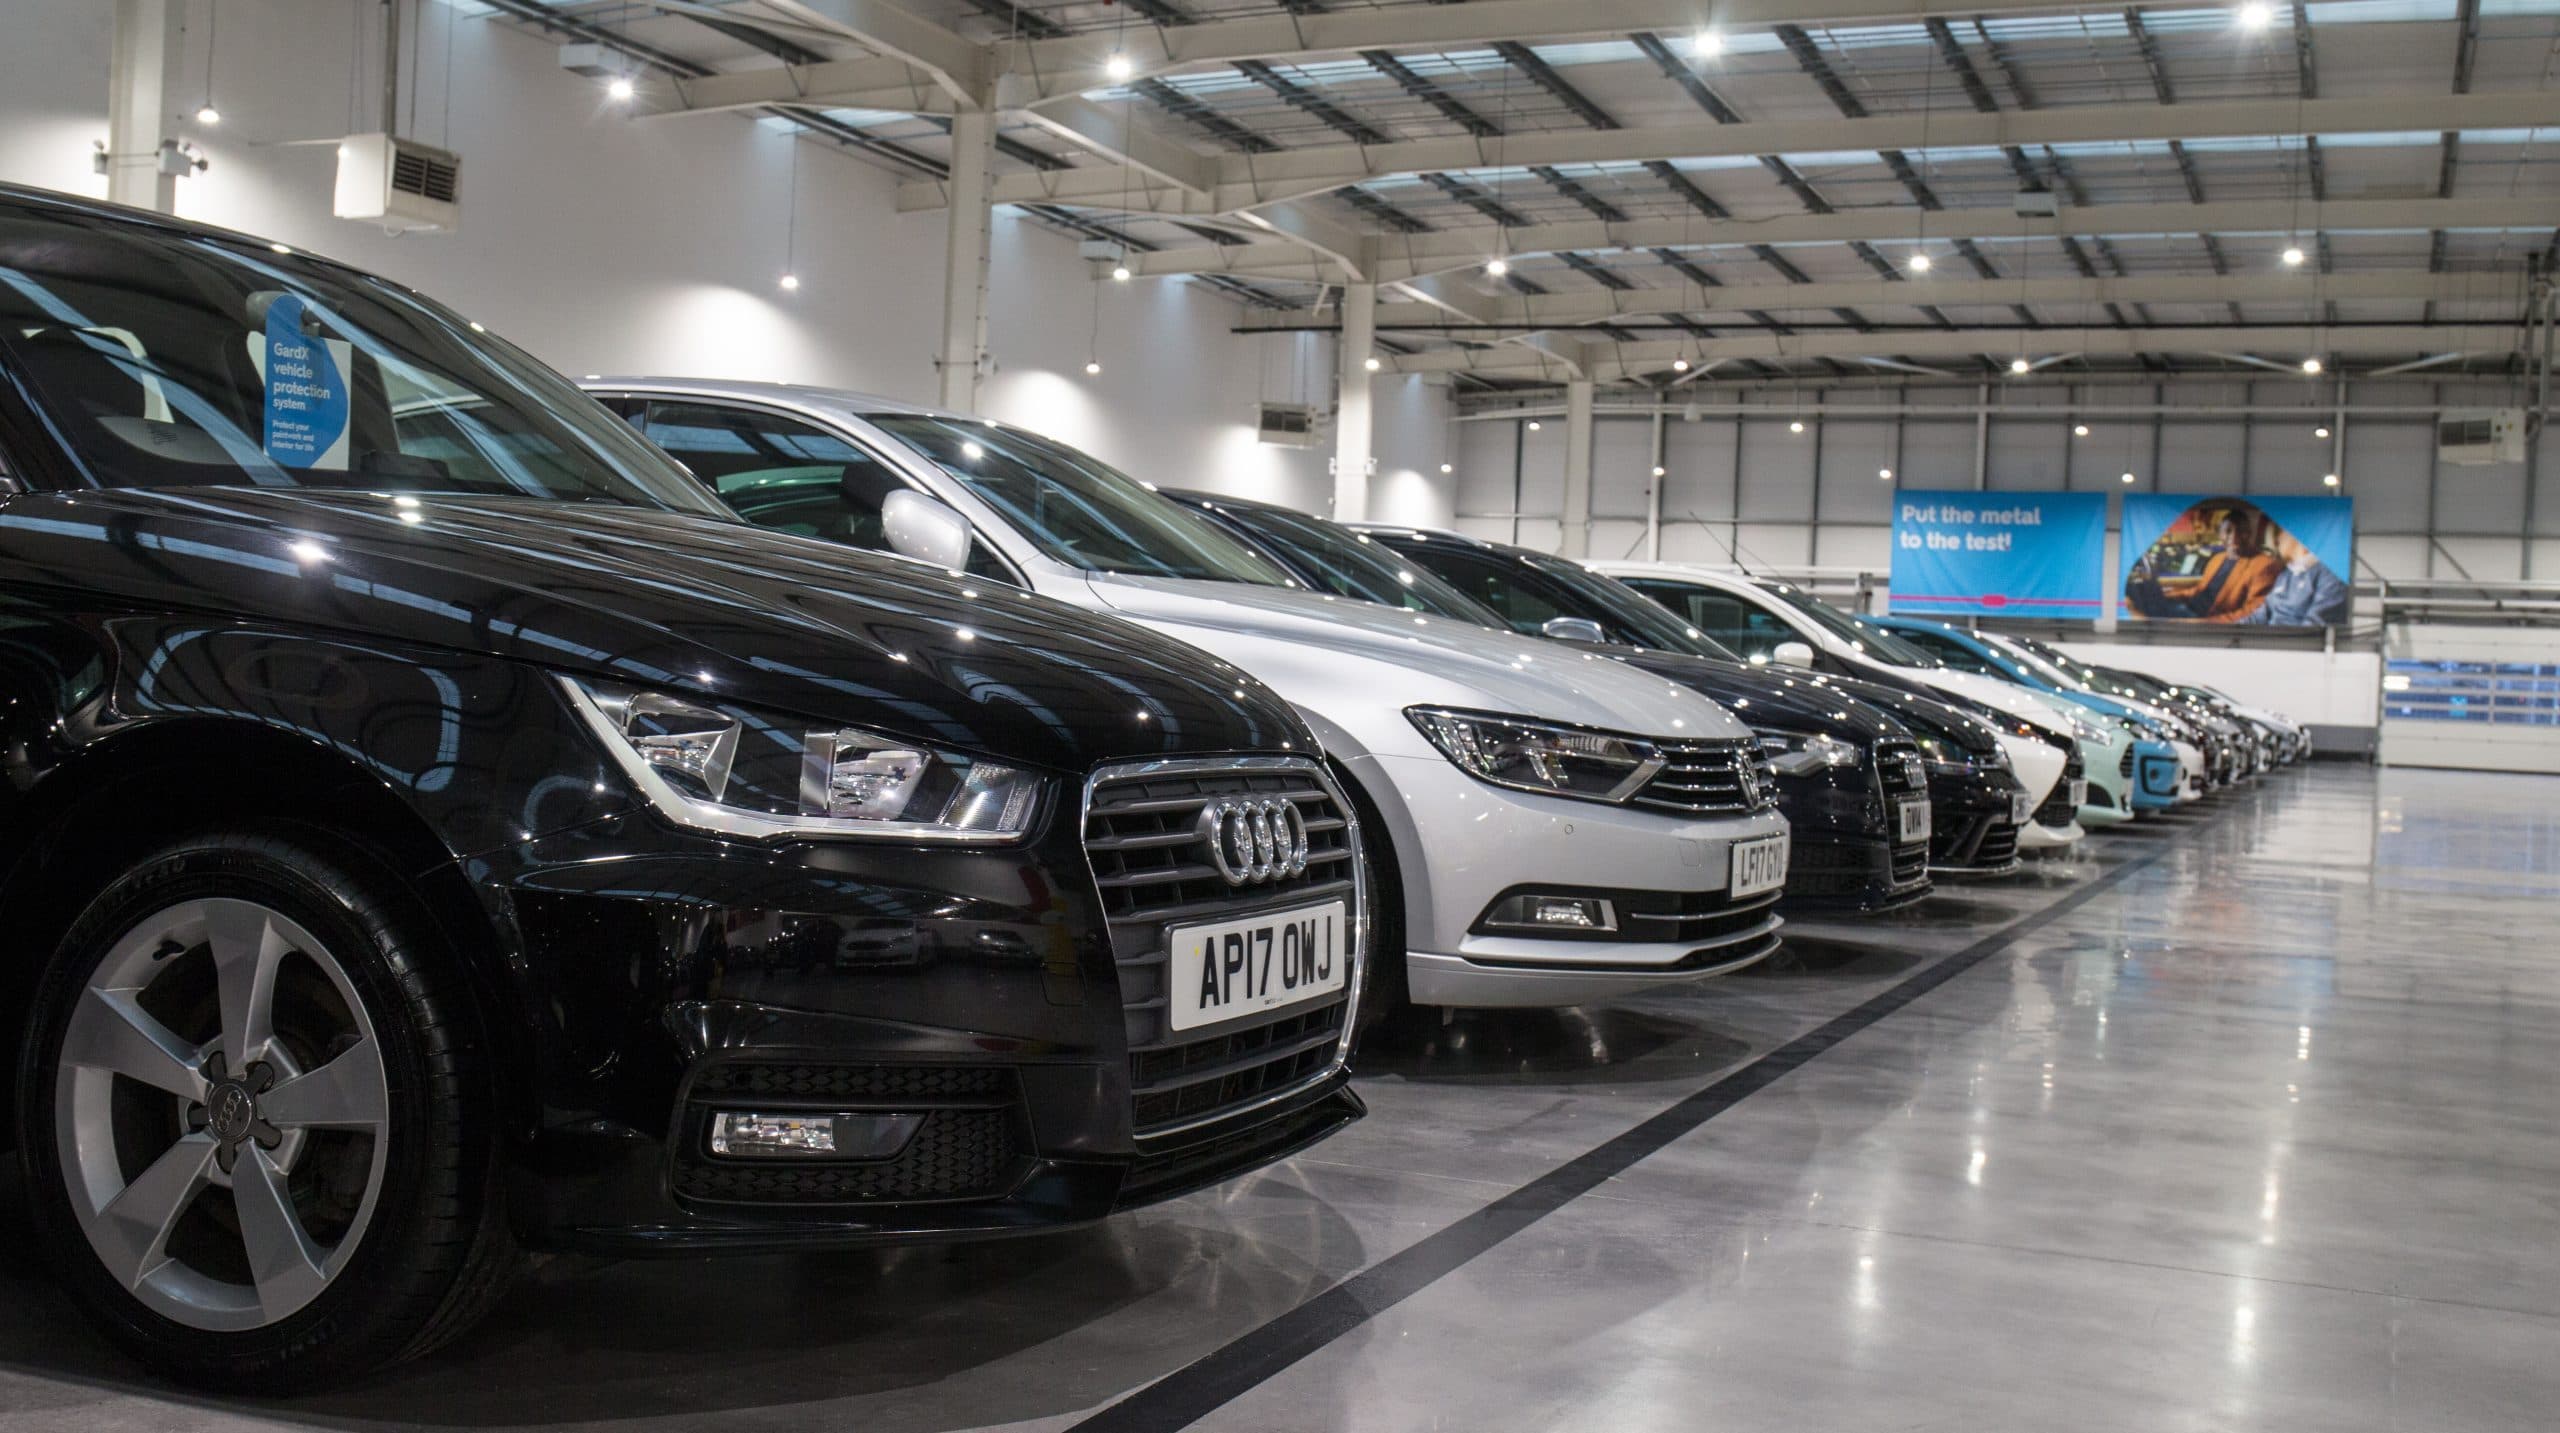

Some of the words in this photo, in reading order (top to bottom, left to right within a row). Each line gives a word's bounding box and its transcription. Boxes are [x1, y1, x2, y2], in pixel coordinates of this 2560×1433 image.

[274, 342, 309, 360] GardX
[273, 362, 312, 378] vehicle
[273, 381, 330, 399] protection
[272, 397, 306, 411] system
[1902, 505, 1936, 522] Put
[1941, 506, 1975, 524] the
[1980, 507, 2041, 525] metal
[1901, 531, 1922, 549] to
[1927, 531, 1960, 550] the
[1966, 532, 2012, 551] test!
[1741, 846, 1766, 887] LF17
[1200, 927, 1273, 1009] AP17
[1283, 915, 1331, 990] OWJ
